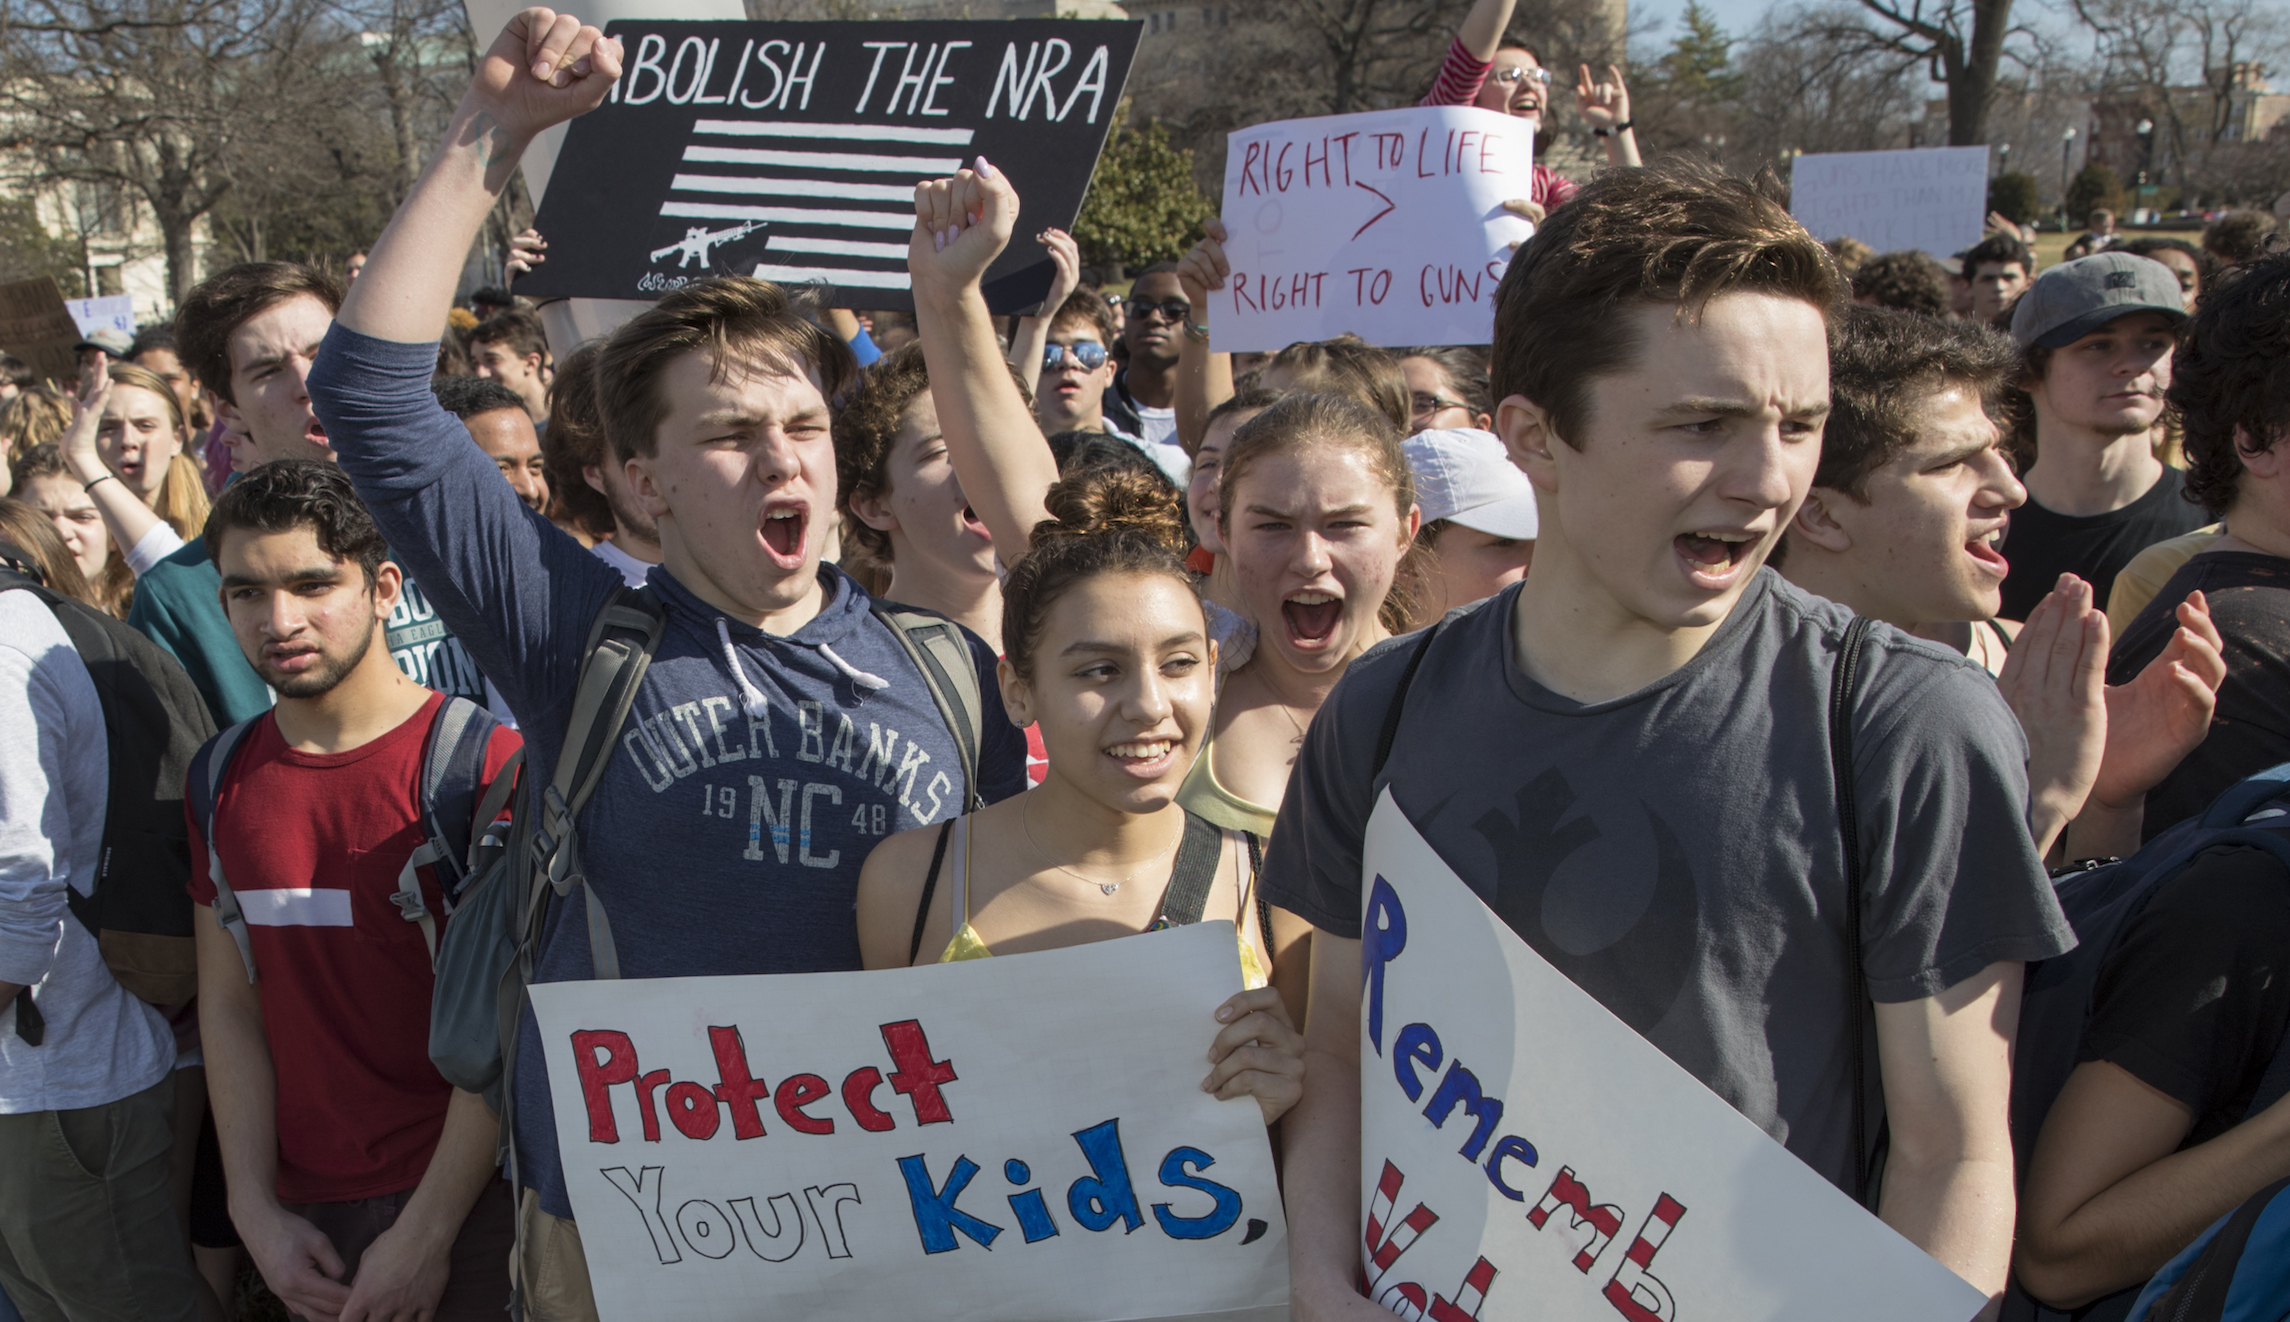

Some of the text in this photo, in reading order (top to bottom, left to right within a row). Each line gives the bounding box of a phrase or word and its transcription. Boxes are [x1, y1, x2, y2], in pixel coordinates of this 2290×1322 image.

[855, 41, 972, 116] THE
[985, 38, 1109, 124] NRA
[1239, 127, 1505, 197] RIGHT TO LIFE
[1233, 272, 1329, 316] RIGHT
[1348, 268, 1392, 307] TO
[623, 696, 951, 825] OUTER BANKS
[702, 775, 886, 869] 19 NC 48
[570, 1019, 958, 1144] Protect
[600, 1117, 1269, 1265] Your Kids,
